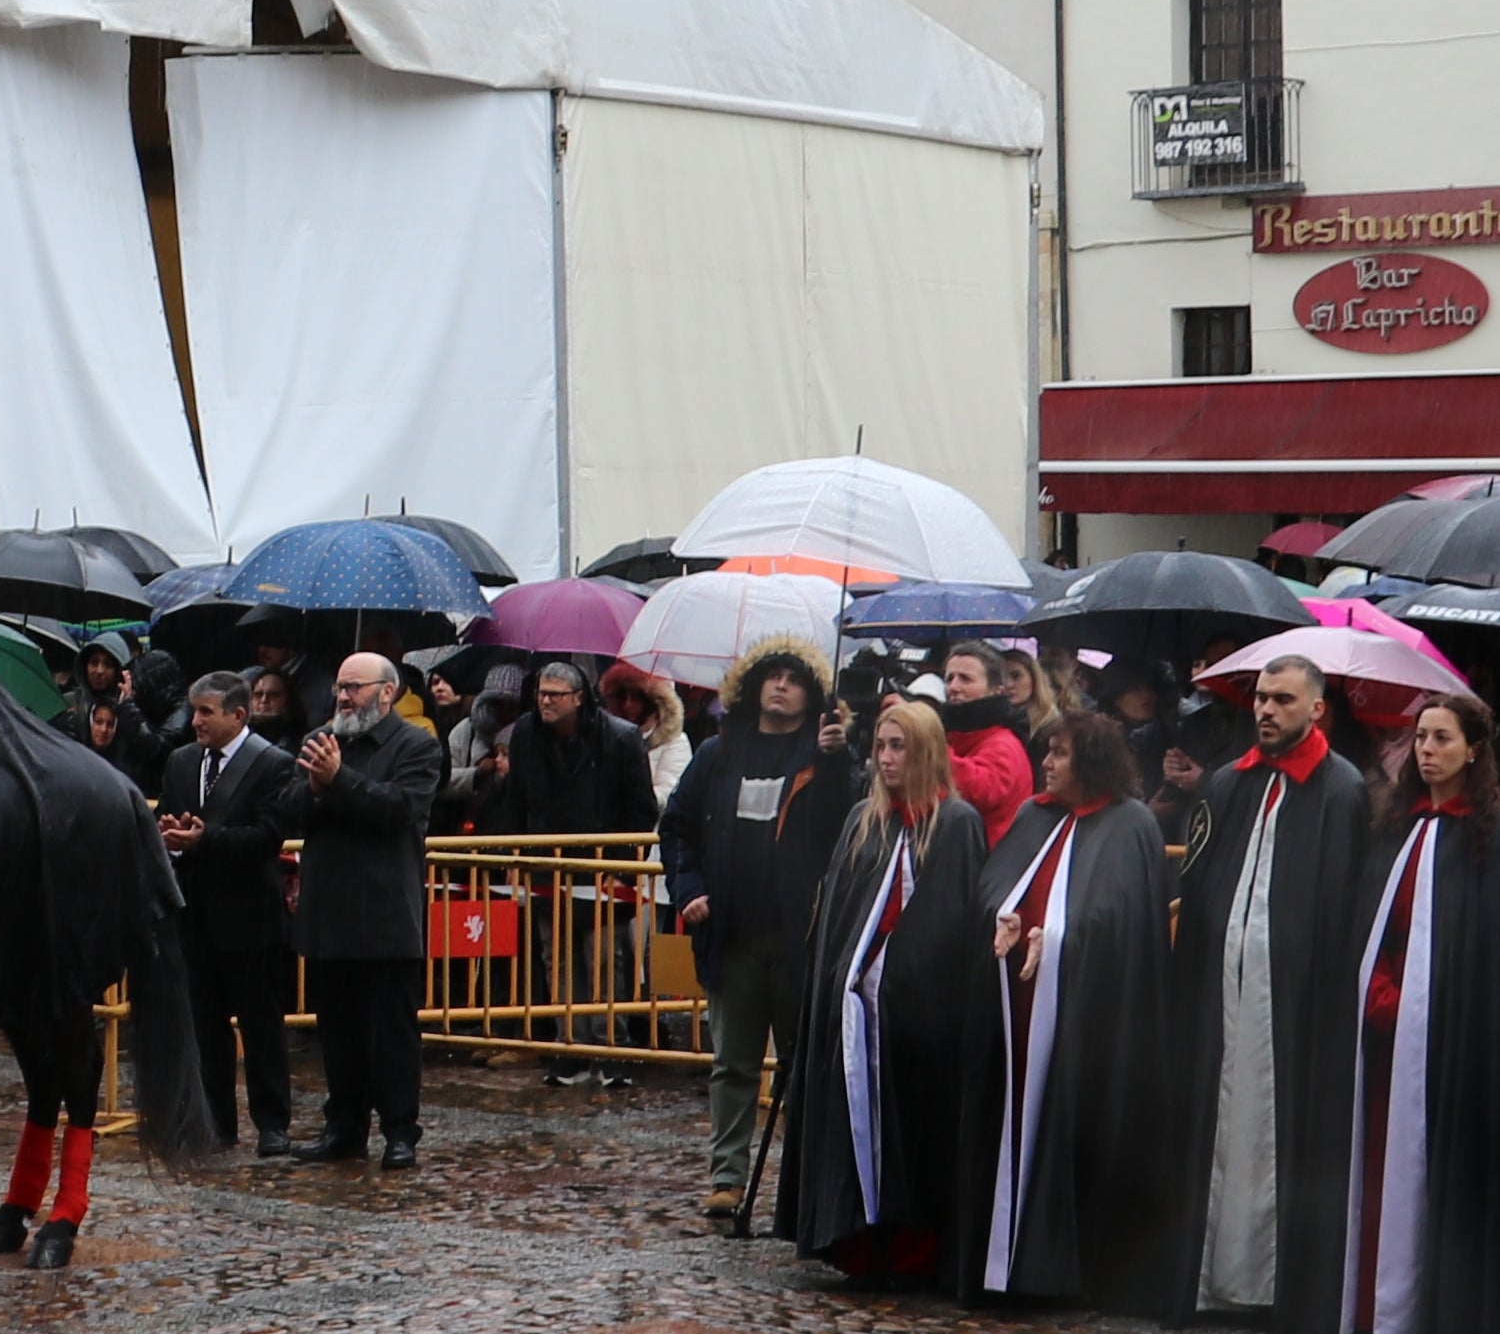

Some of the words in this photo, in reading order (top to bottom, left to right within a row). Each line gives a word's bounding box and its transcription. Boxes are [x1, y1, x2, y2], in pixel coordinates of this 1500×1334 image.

[1167, 120, 1229, 138] ALQUILA
[1155, 140, 1182, 160] 987
[1185, 138, 1212, 157] 192
[1214, 135, 1243, 155] 316
[1353, 257, 1421, 290] Bar
[1341, 294, 1478, 340] Capricho
